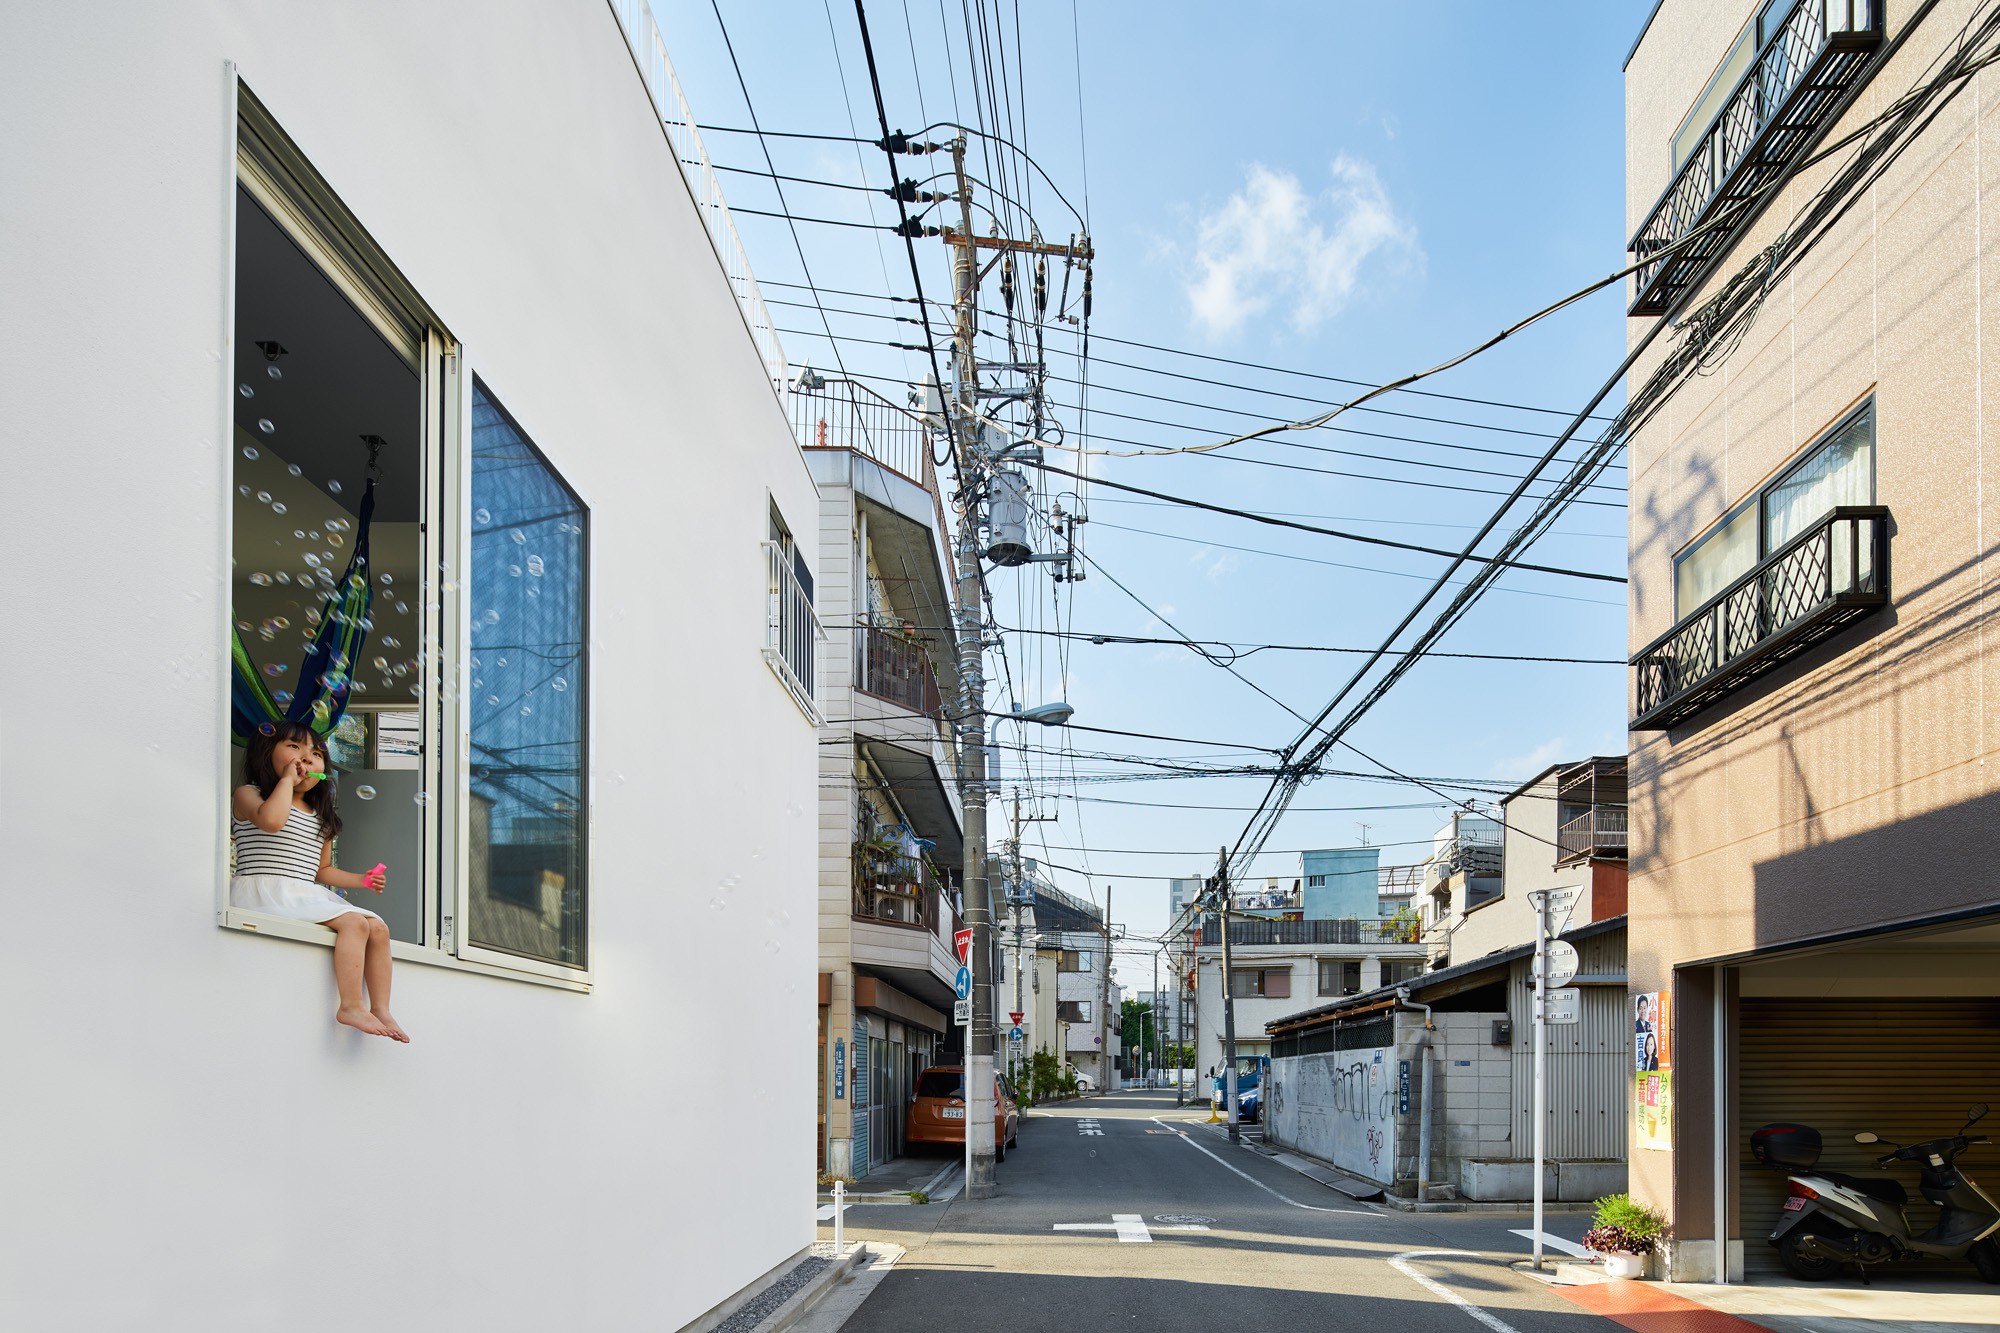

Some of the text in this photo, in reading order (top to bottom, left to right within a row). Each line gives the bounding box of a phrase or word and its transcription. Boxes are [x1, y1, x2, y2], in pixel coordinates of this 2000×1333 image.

[957, 936, 969, 945] 止まれ
[1637, 1036, 1645, 1063] 吉良
